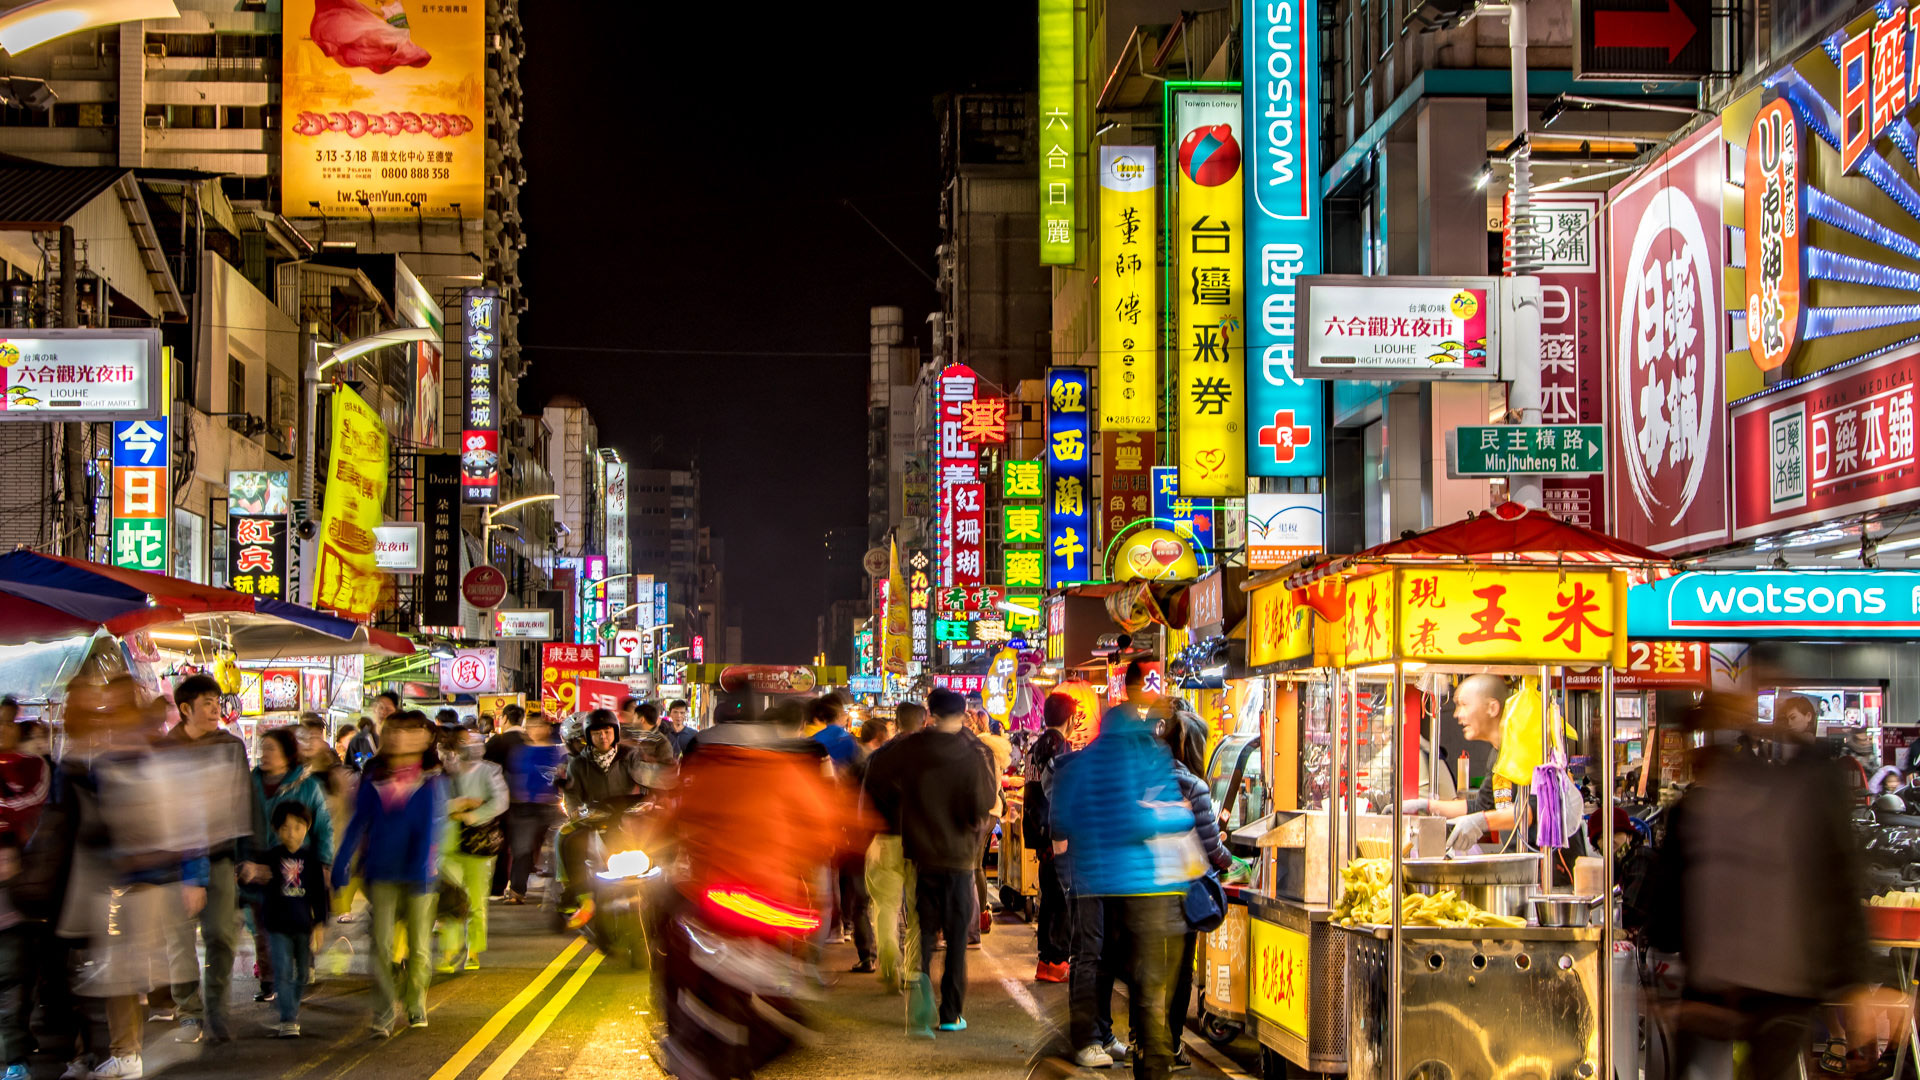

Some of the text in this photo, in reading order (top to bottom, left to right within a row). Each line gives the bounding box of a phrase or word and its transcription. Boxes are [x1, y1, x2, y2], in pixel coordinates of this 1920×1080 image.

[1265, 1, 1294, 187] watsons
[1840, 4, 1920, 177] 日藥
[1184, 100, 1238, 109] Taiwan Lottery
[316, 150, 337, 162] 3/13
[371, 150, 425, 163] 高雄文化中心
[427, 150, 453, 163] 至德堂
[381, 167, 408, 179] 0800
[411, 167, 430, 179] 888
[432, 167, 450, 179] 358
[1045, 106, 1071, 244] 六合日麗
[337, 190, 428, 203] tw.ShenYun.com
[1190, 214, 1241, 416] 台灣彩券
[1408, 303, 1447, 314] 台湾の味
[1324, 315, 1453, 338] 六合觀光夜市
[1579, 289, 1589, 355] JAPAN
[23, 353, 58, 362] 台湾の味
[1374, 344, 1417, 354] LIOUHE
[1357, 356, 1417, 365] NIGHT MARKET
[17, 364, 134, 384] 六合觀光夜市
[50, 388, 89, 398] LIOUHE
[1812, 368, 1914, 413] JAPAN MEDICAL
[1115, 415, 1151, 425] 2857622
[1480, 429, 1584, 450] 民主橫路
[1561, 453, 1580, 470] Rd.
[429, 473, 458, 485] Doris
[1050, 378, 1086, 570] 紐西蘭牛
[1111, 474, 1149, 492] 出租
[117, 420, 164, 568] 今日蛇
[954, 486, 981, 578] 紅珊瑚
[1006, 461, 1041, 631] 遠東藥局
[1696, 583, 1887, 614] watsons
[1408, 575, 1446, 657] 現煮
[1457, 581, 1615, 654] 玉米
[548, 646, 595, 663] 康是美
[936, 676, 987, 689] 腳底按
